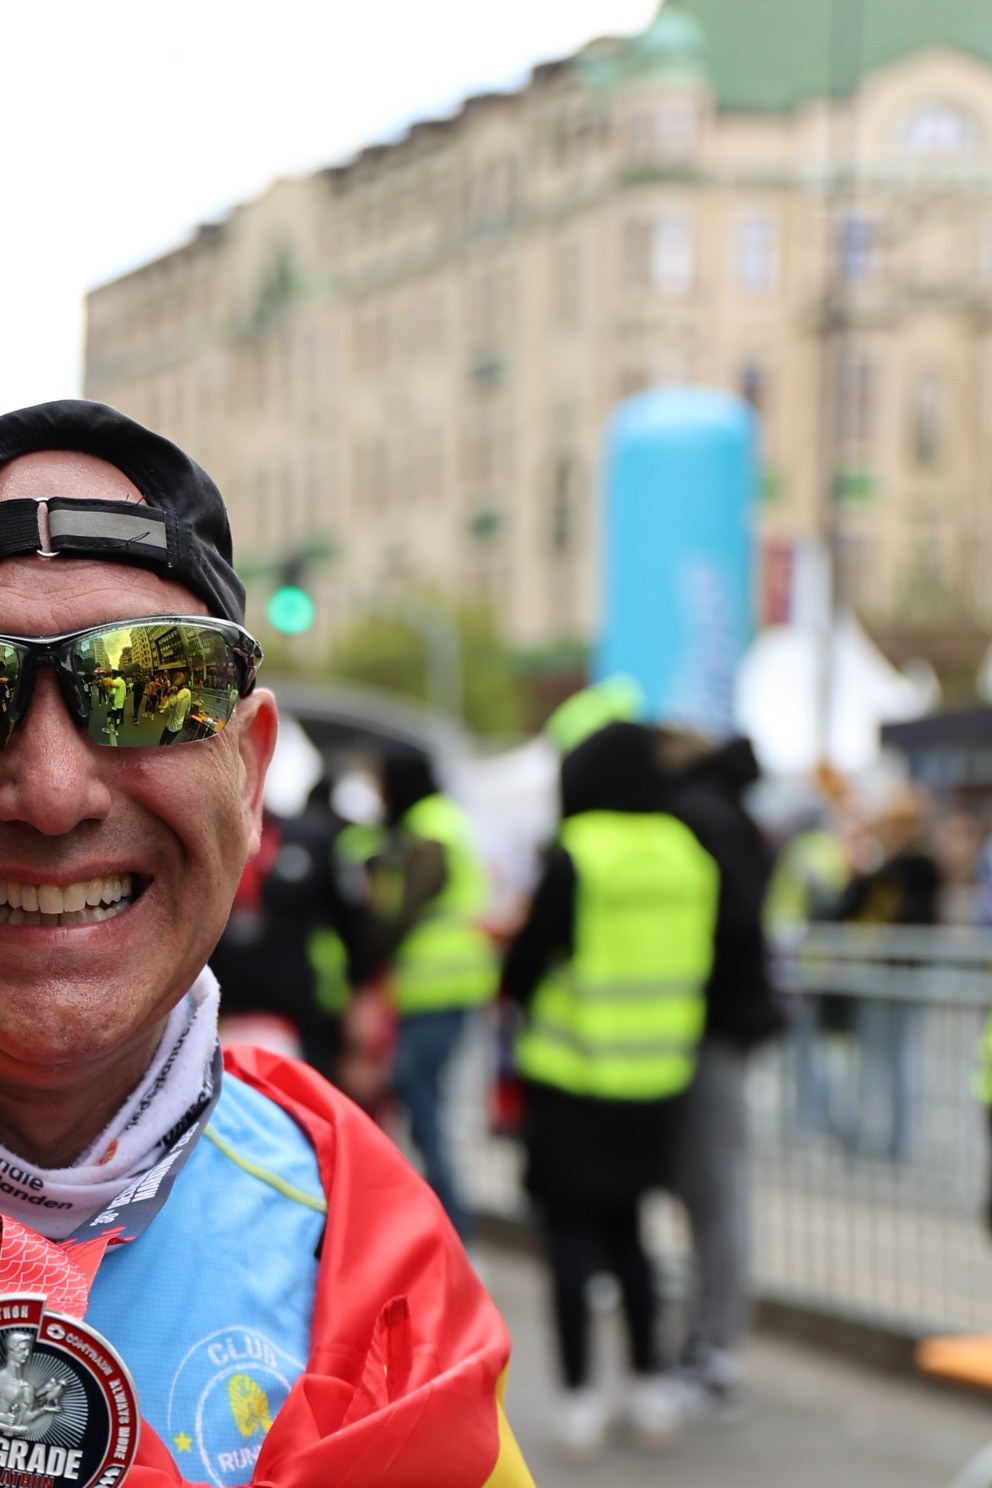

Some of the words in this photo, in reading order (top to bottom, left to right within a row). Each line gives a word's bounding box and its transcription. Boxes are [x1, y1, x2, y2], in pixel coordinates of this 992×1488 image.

[65, 1332, 113, 1376] COMTRADE
[109, 1378, 131, 1425] ALWAYS
[113, 1426, 131, 1460] MORE
